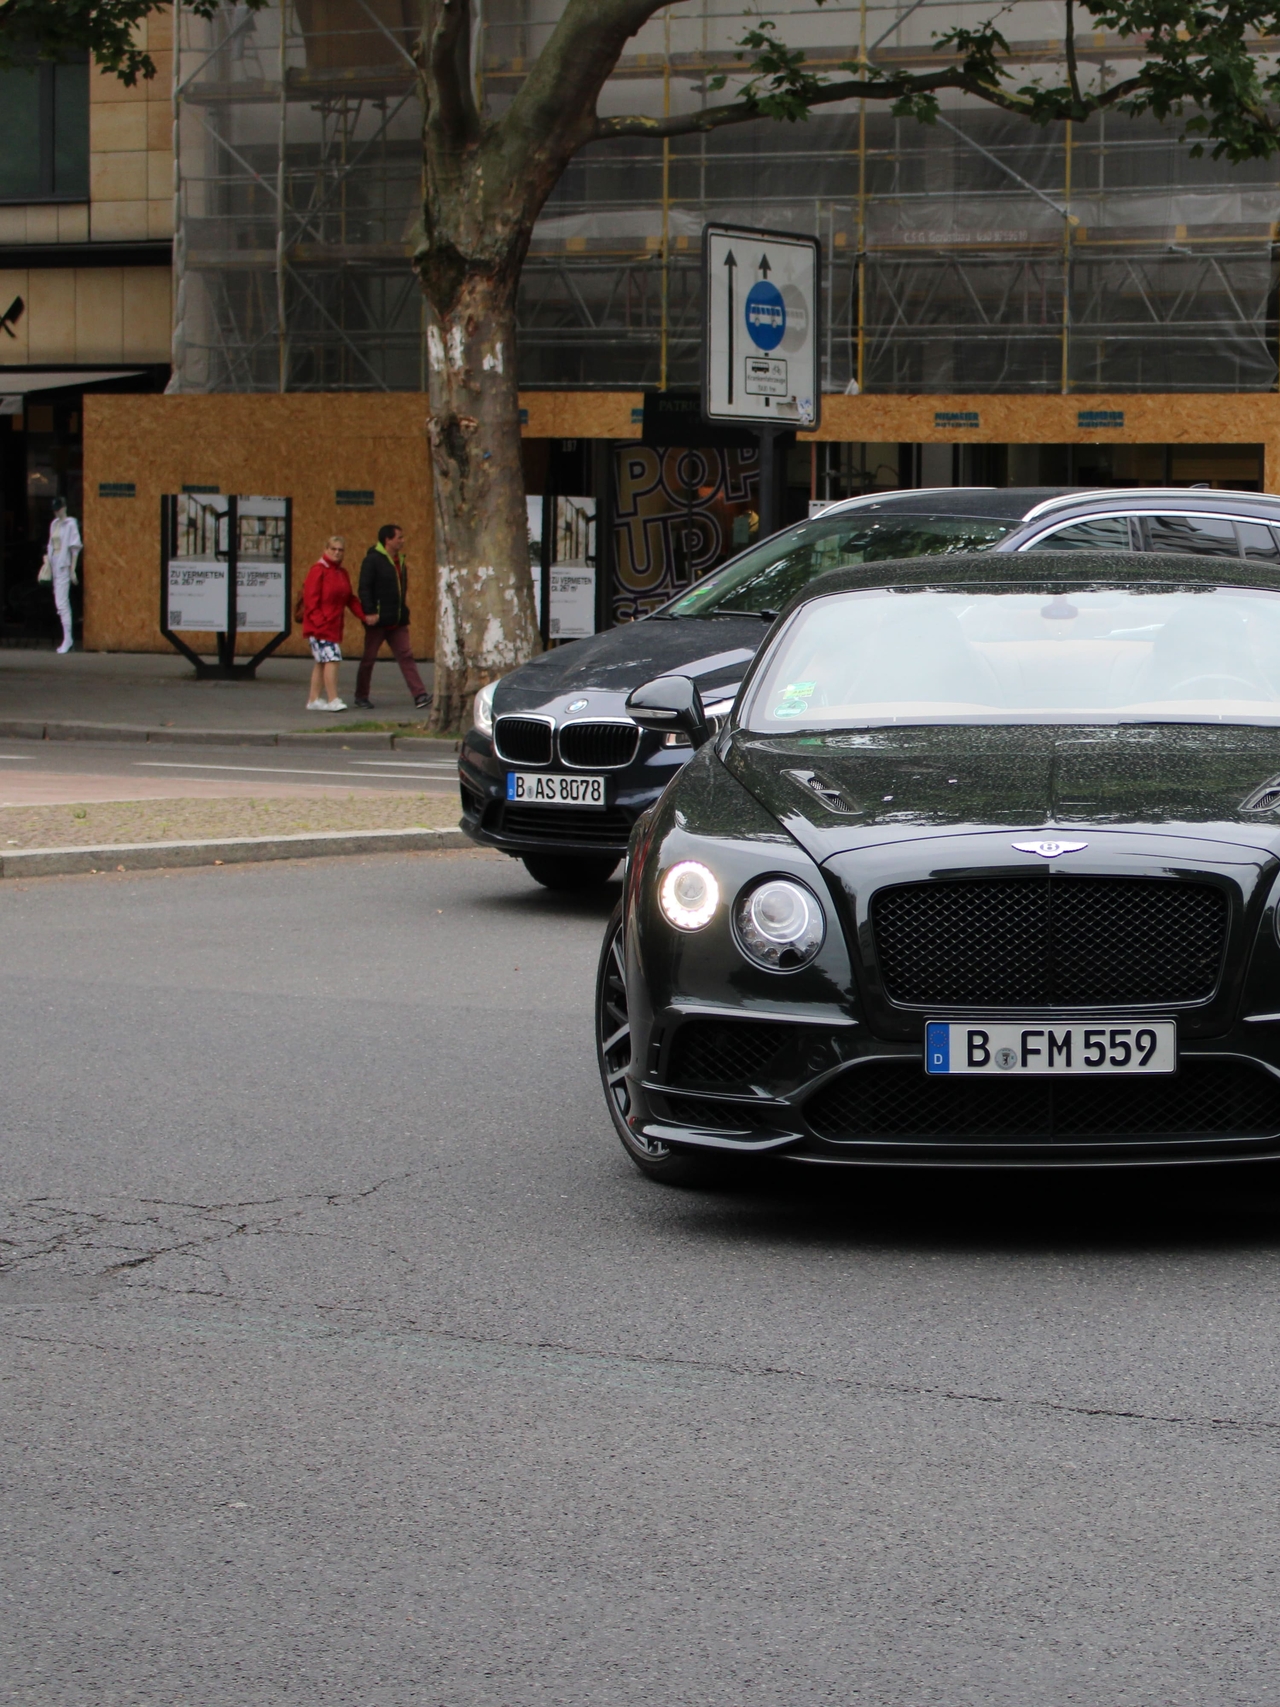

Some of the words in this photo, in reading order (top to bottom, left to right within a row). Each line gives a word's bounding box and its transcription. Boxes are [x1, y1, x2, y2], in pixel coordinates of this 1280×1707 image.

[614, 443, 760, 519] POP
[613, 510, 723, 594] UP
[170, 570, 181, 578] ZU
[182, 571, 225, 579] VERMIETEN
[516, 776, 525, 798] B
[535, 778, 556, 800] AS
[560, 778, 601, 802] 8078
[933, 1053, 943, 1065] D
[966, 1029, 992, 1068] B
[1020, 1029, 1073, 1068] FM
[1083, 1028, 1158, 1067] 559
